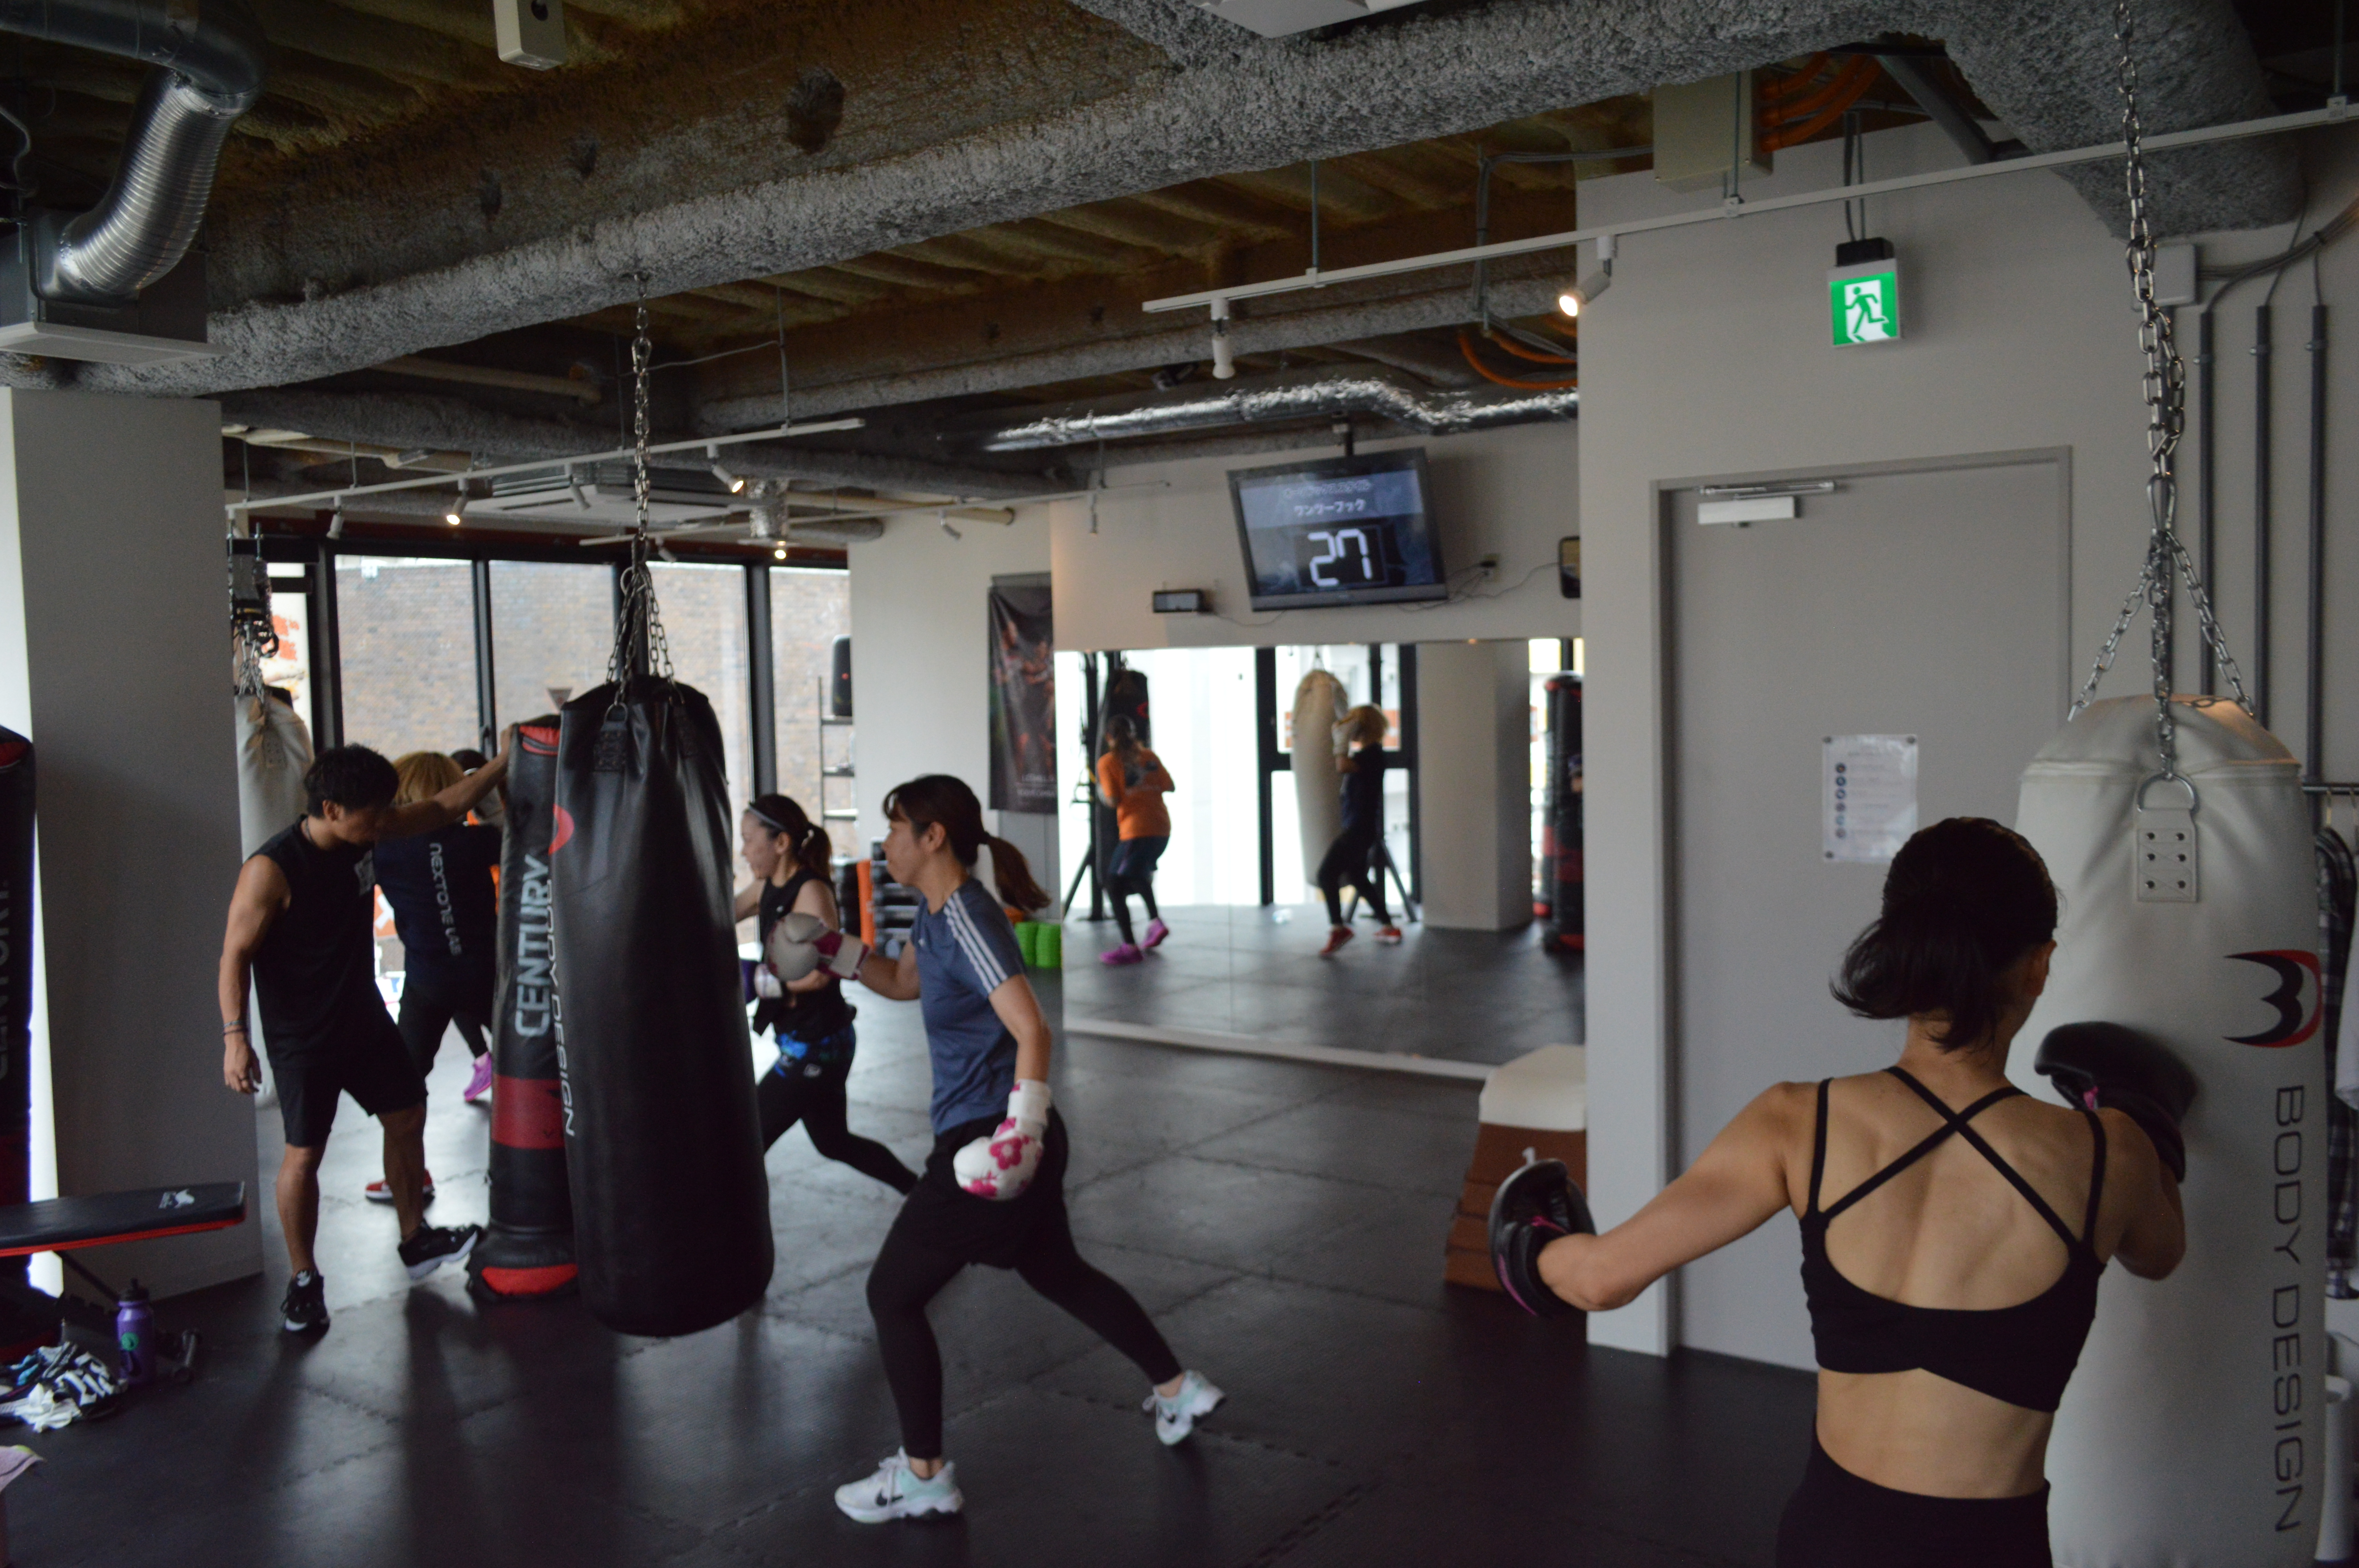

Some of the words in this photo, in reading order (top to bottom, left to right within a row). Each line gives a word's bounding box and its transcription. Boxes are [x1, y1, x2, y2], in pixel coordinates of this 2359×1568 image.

[1308, 528, 1373, 587] 27
[515, 854, 551, 1037] CENTURY
[551, 994, 575, 1136] DESIGN
[2274, 1085, 2304, 1265] BODY
[2273, 1284, 2303, 1532] DESIGN
